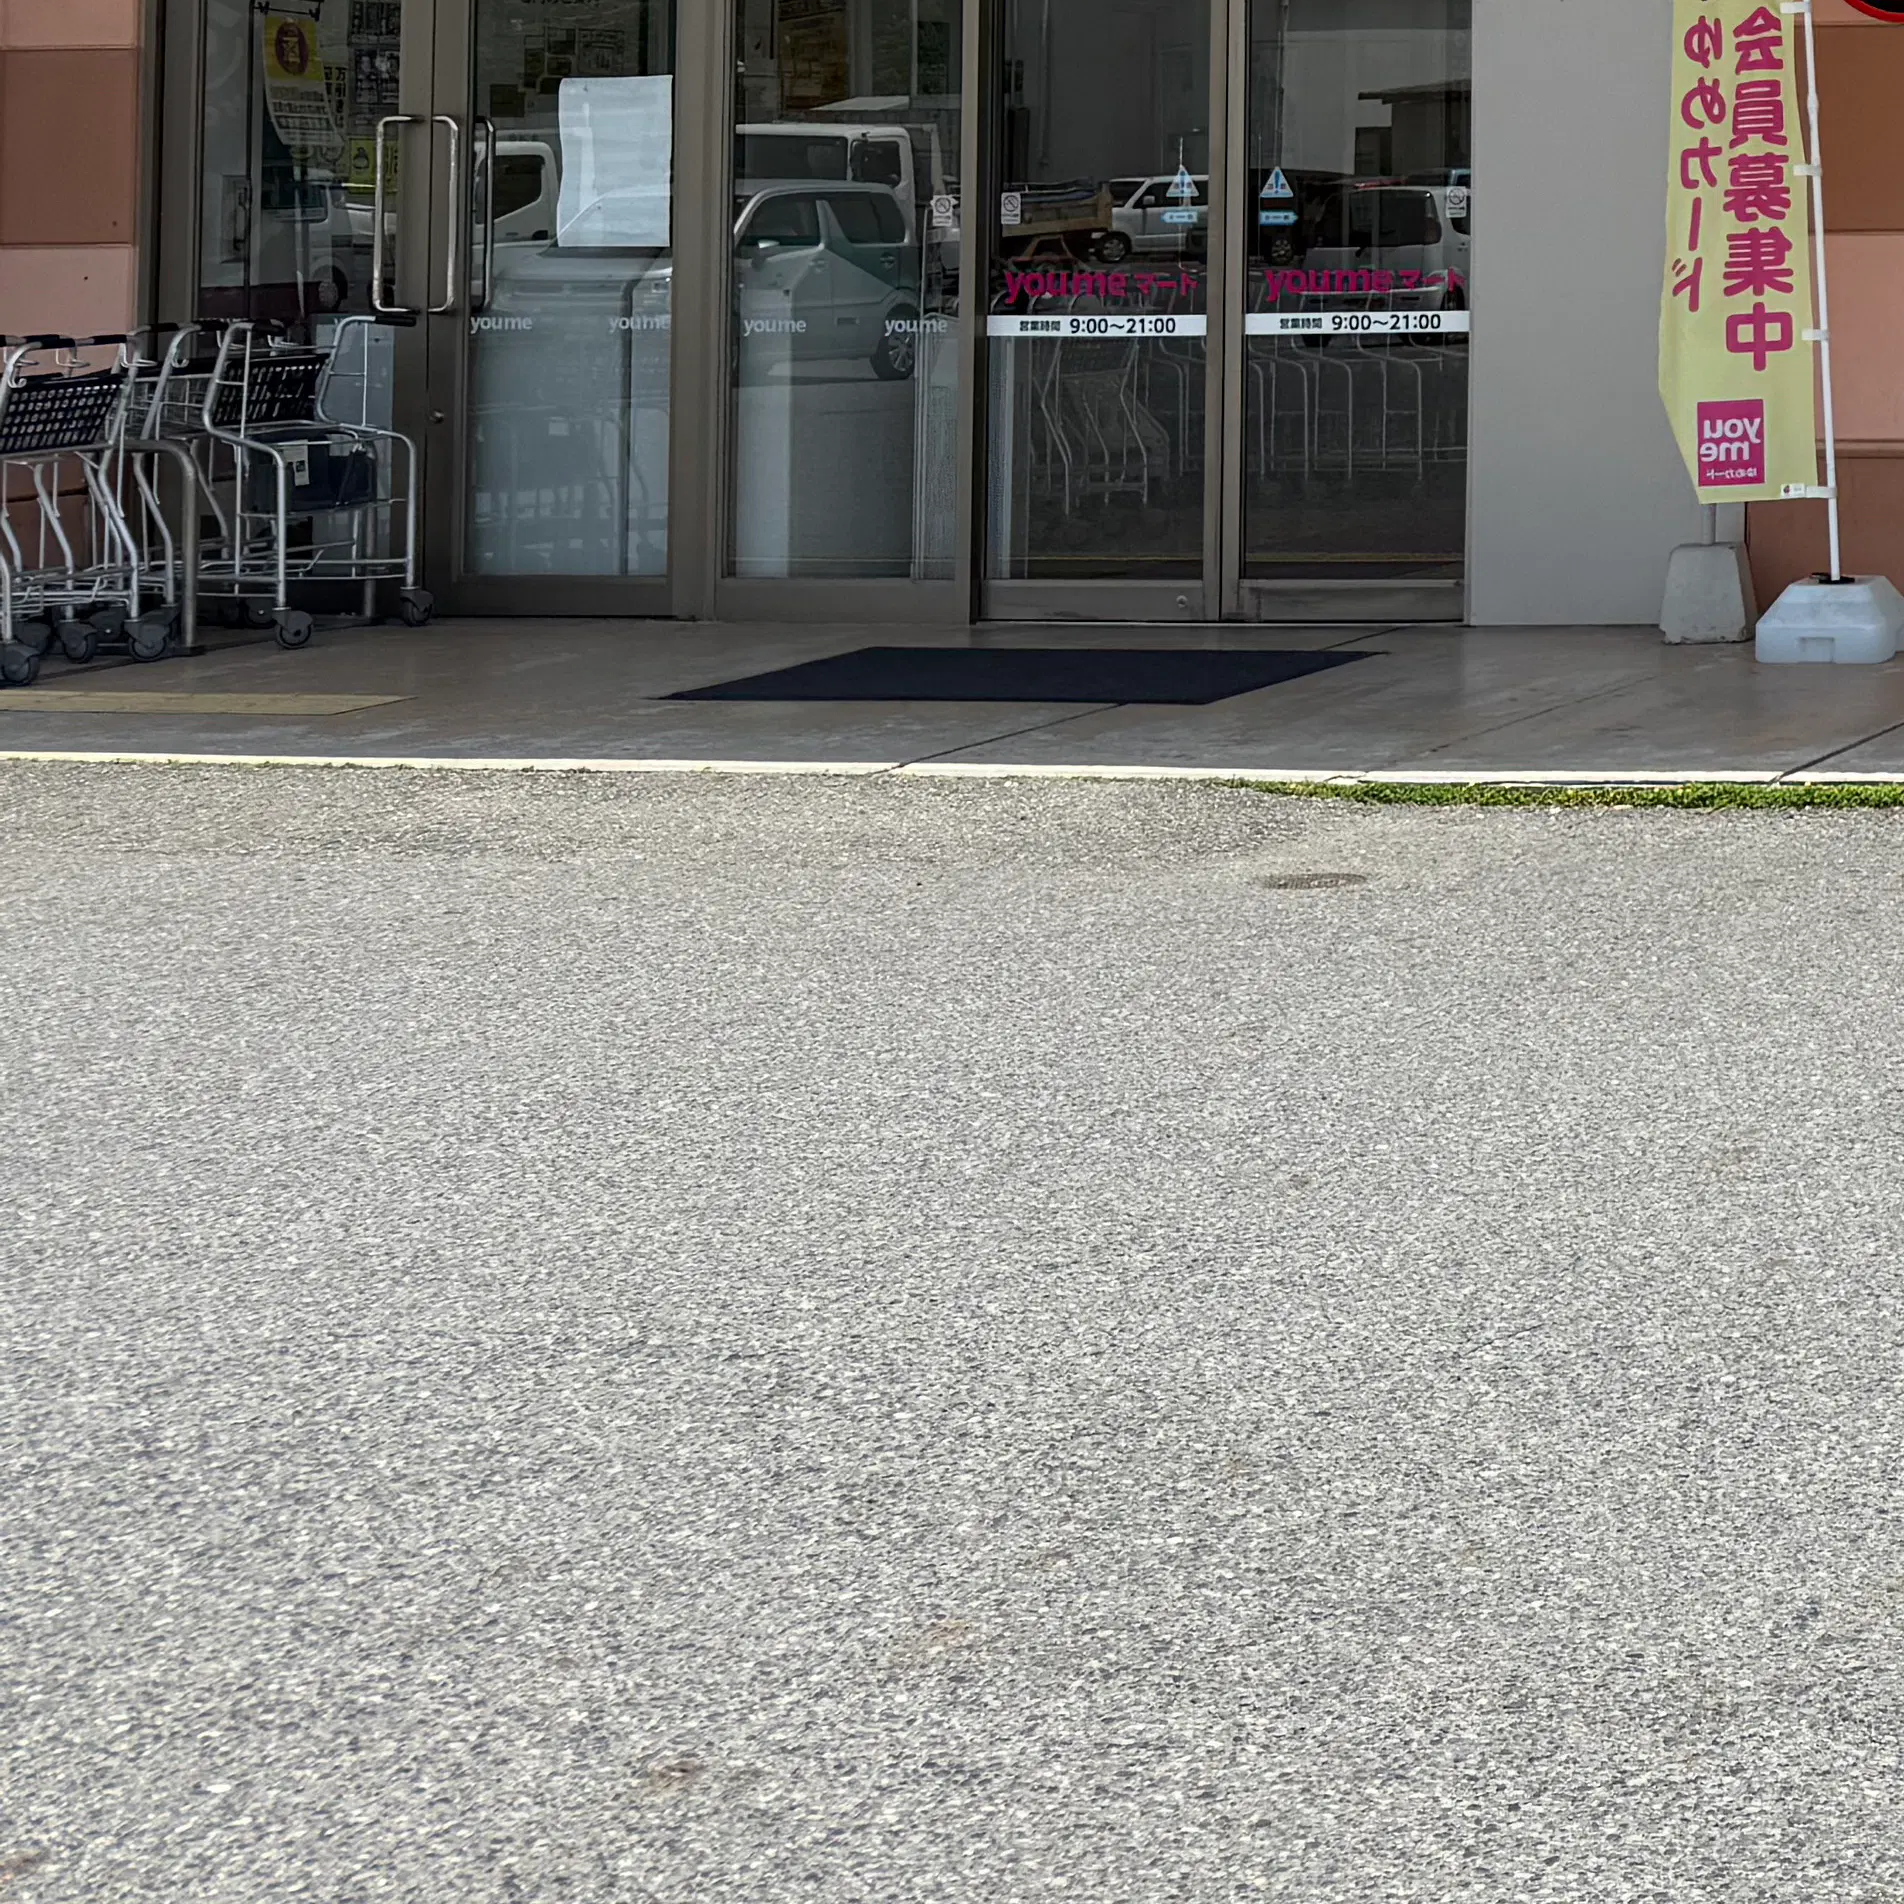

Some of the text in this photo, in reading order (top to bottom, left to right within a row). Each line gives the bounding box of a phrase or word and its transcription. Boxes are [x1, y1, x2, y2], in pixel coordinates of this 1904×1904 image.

[1004, 269, 1199, 304] youme マート
[1264, 268, 1465, 303] youme マート
[470, 314, 533, 334] youme
[743, 316, 807, 335] youme
[884, 315, 948, 335] youme
[1069, 317, 1176, 335] 9:00～21:00
[1332, 314, 1442, 332] 9:00～21:00
